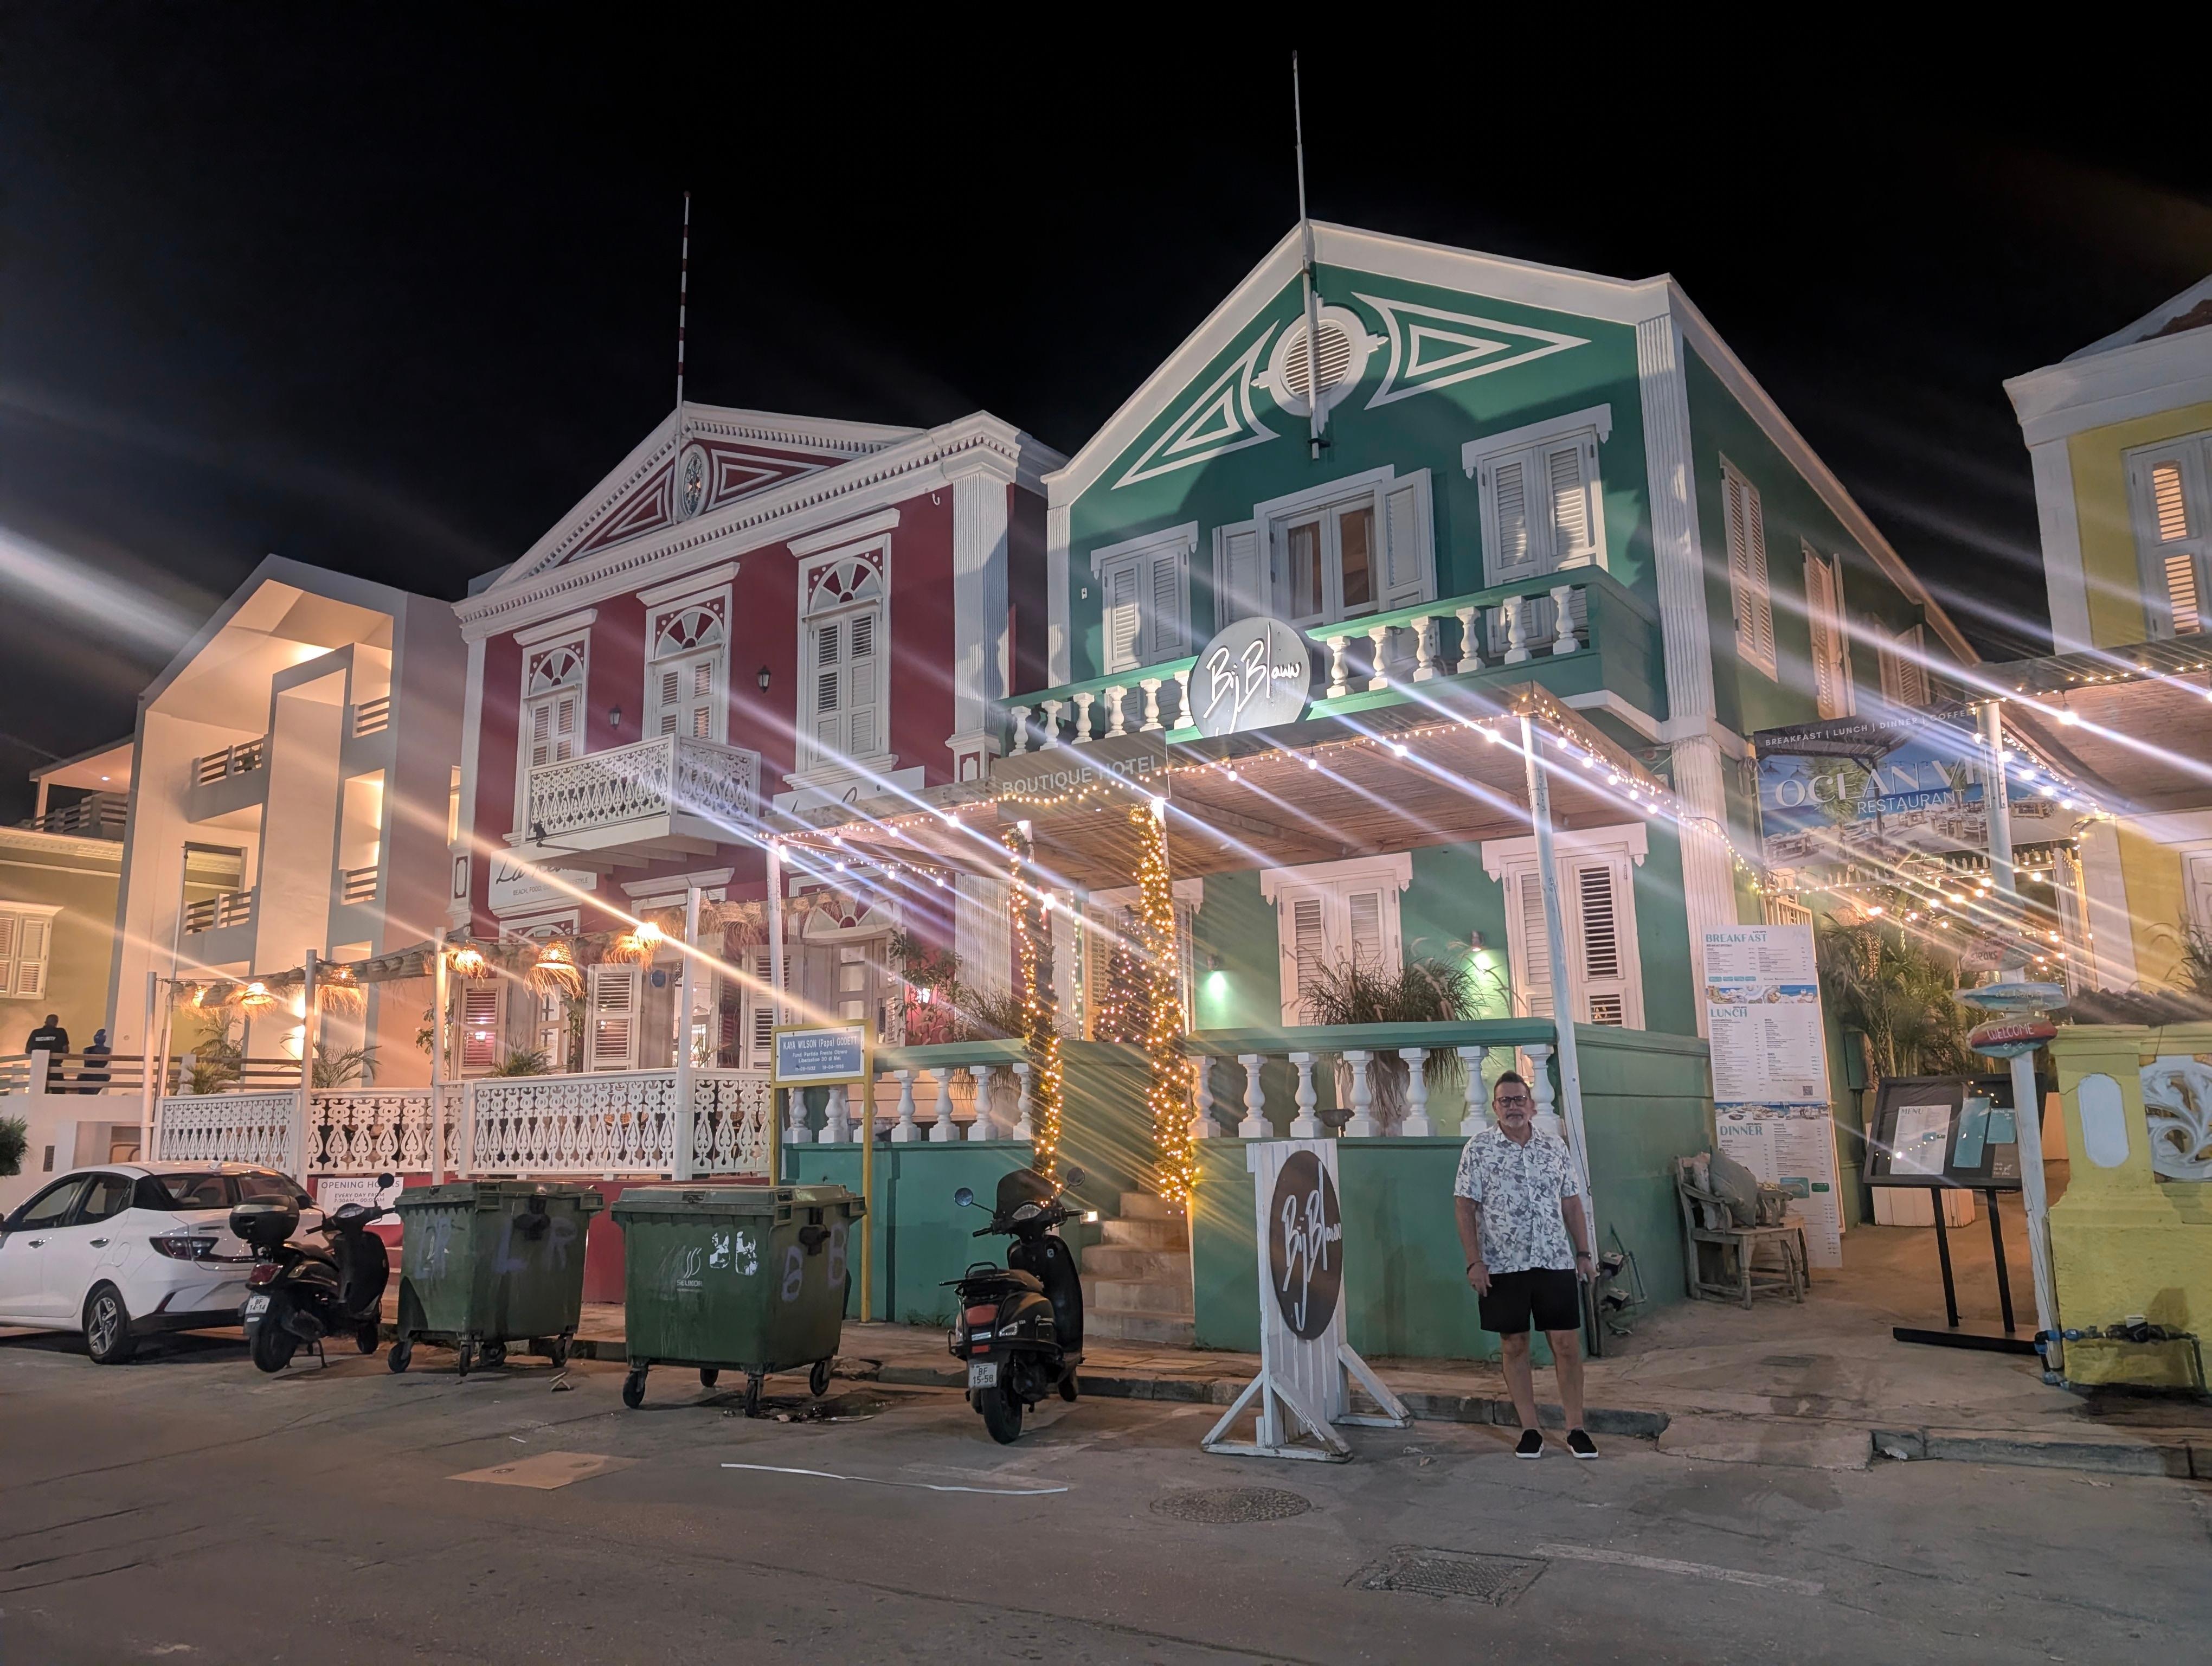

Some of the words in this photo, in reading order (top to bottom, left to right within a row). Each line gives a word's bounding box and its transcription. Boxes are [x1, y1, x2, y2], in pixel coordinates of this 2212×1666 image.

[1203, 646, 1240, 736] Bij
[1765, 732, 1822, 746] BREAKFAST
[1833, 725, 1868, 736] LUNCH
[1880, 717, 1918, 729] DINNER
[1002, 766, 1094, 796] BOUTIQUE
[1099, 754, 1162, 781] HOTEL
[1775, 763, 1920, 808] OCEAN
[1857, 788, 1965, 815] RESTAURANT
[1706, 934, 1767, 943] BREAKFAST
[1711, 1008, 1747, 1017] LUNCH
[1986, 1022, 2035, 1041] WELCOME
[783, 1041, 796, 1050] KAYA
[798, 1039, 816, 1048] WILSON
[819, 1037, 834, 1048] (Papa)
[837, 1036, 857, 1046] GODETT
[1720, 1125, 1763, 1136] DINNER
[1281, 1194, 1308, 1332] Bij
[973, 1374, 994, 1385] 15-58
[978, 1367, 988, 1376] BF
